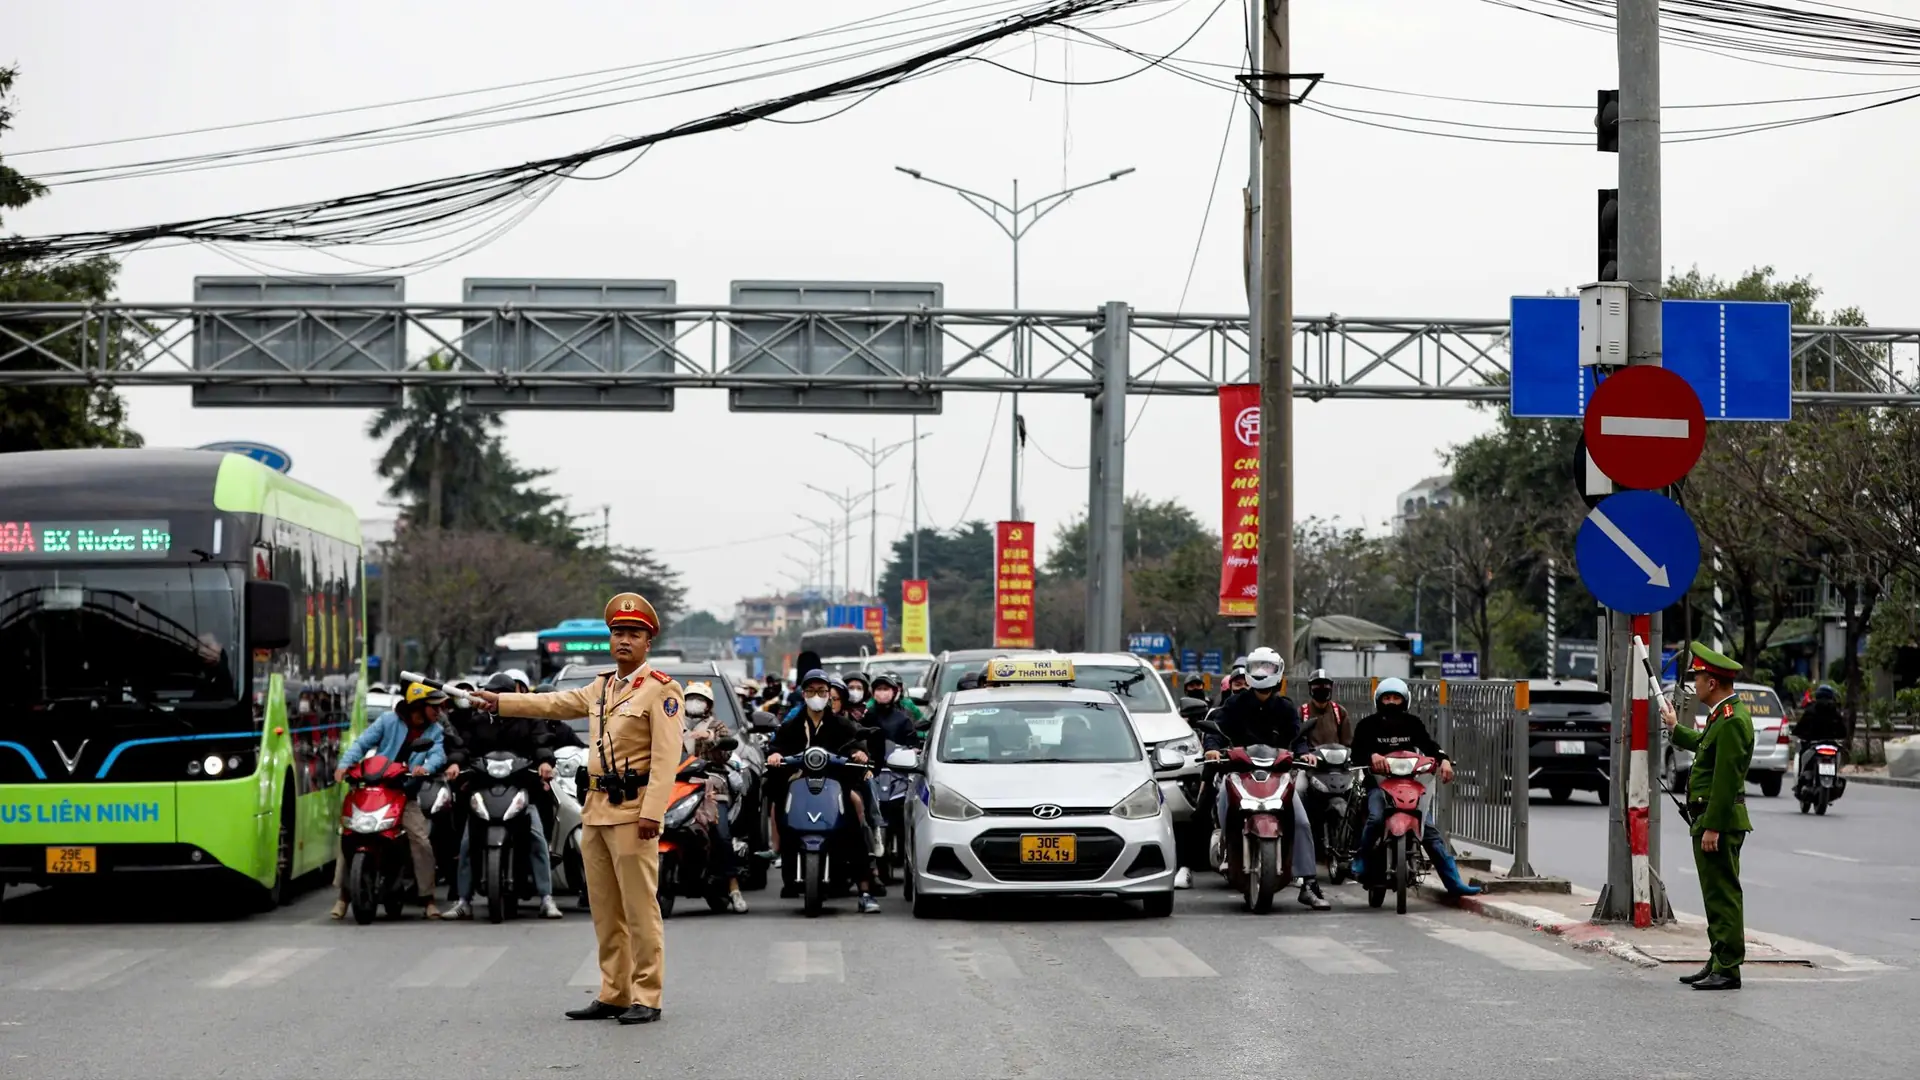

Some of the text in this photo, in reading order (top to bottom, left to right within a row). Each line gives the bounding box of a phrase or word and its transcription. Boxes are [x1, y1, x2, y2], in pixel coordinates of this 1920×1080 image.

[1231, 474, 1260, 489] MỪ
[44, 529, 71, 552] BX
[78, 528, 136, 551] Nước
[1232, 532, 1259, 550] 20
[0, 799, 159, 824] US LIÊN NINH
[1037, 837, 1060, 849] 30E
[60, 849, 82, 860] 29E
[1027, 850, 1070, 861] 334.19
[52, 861, 91, 872] 422.75
